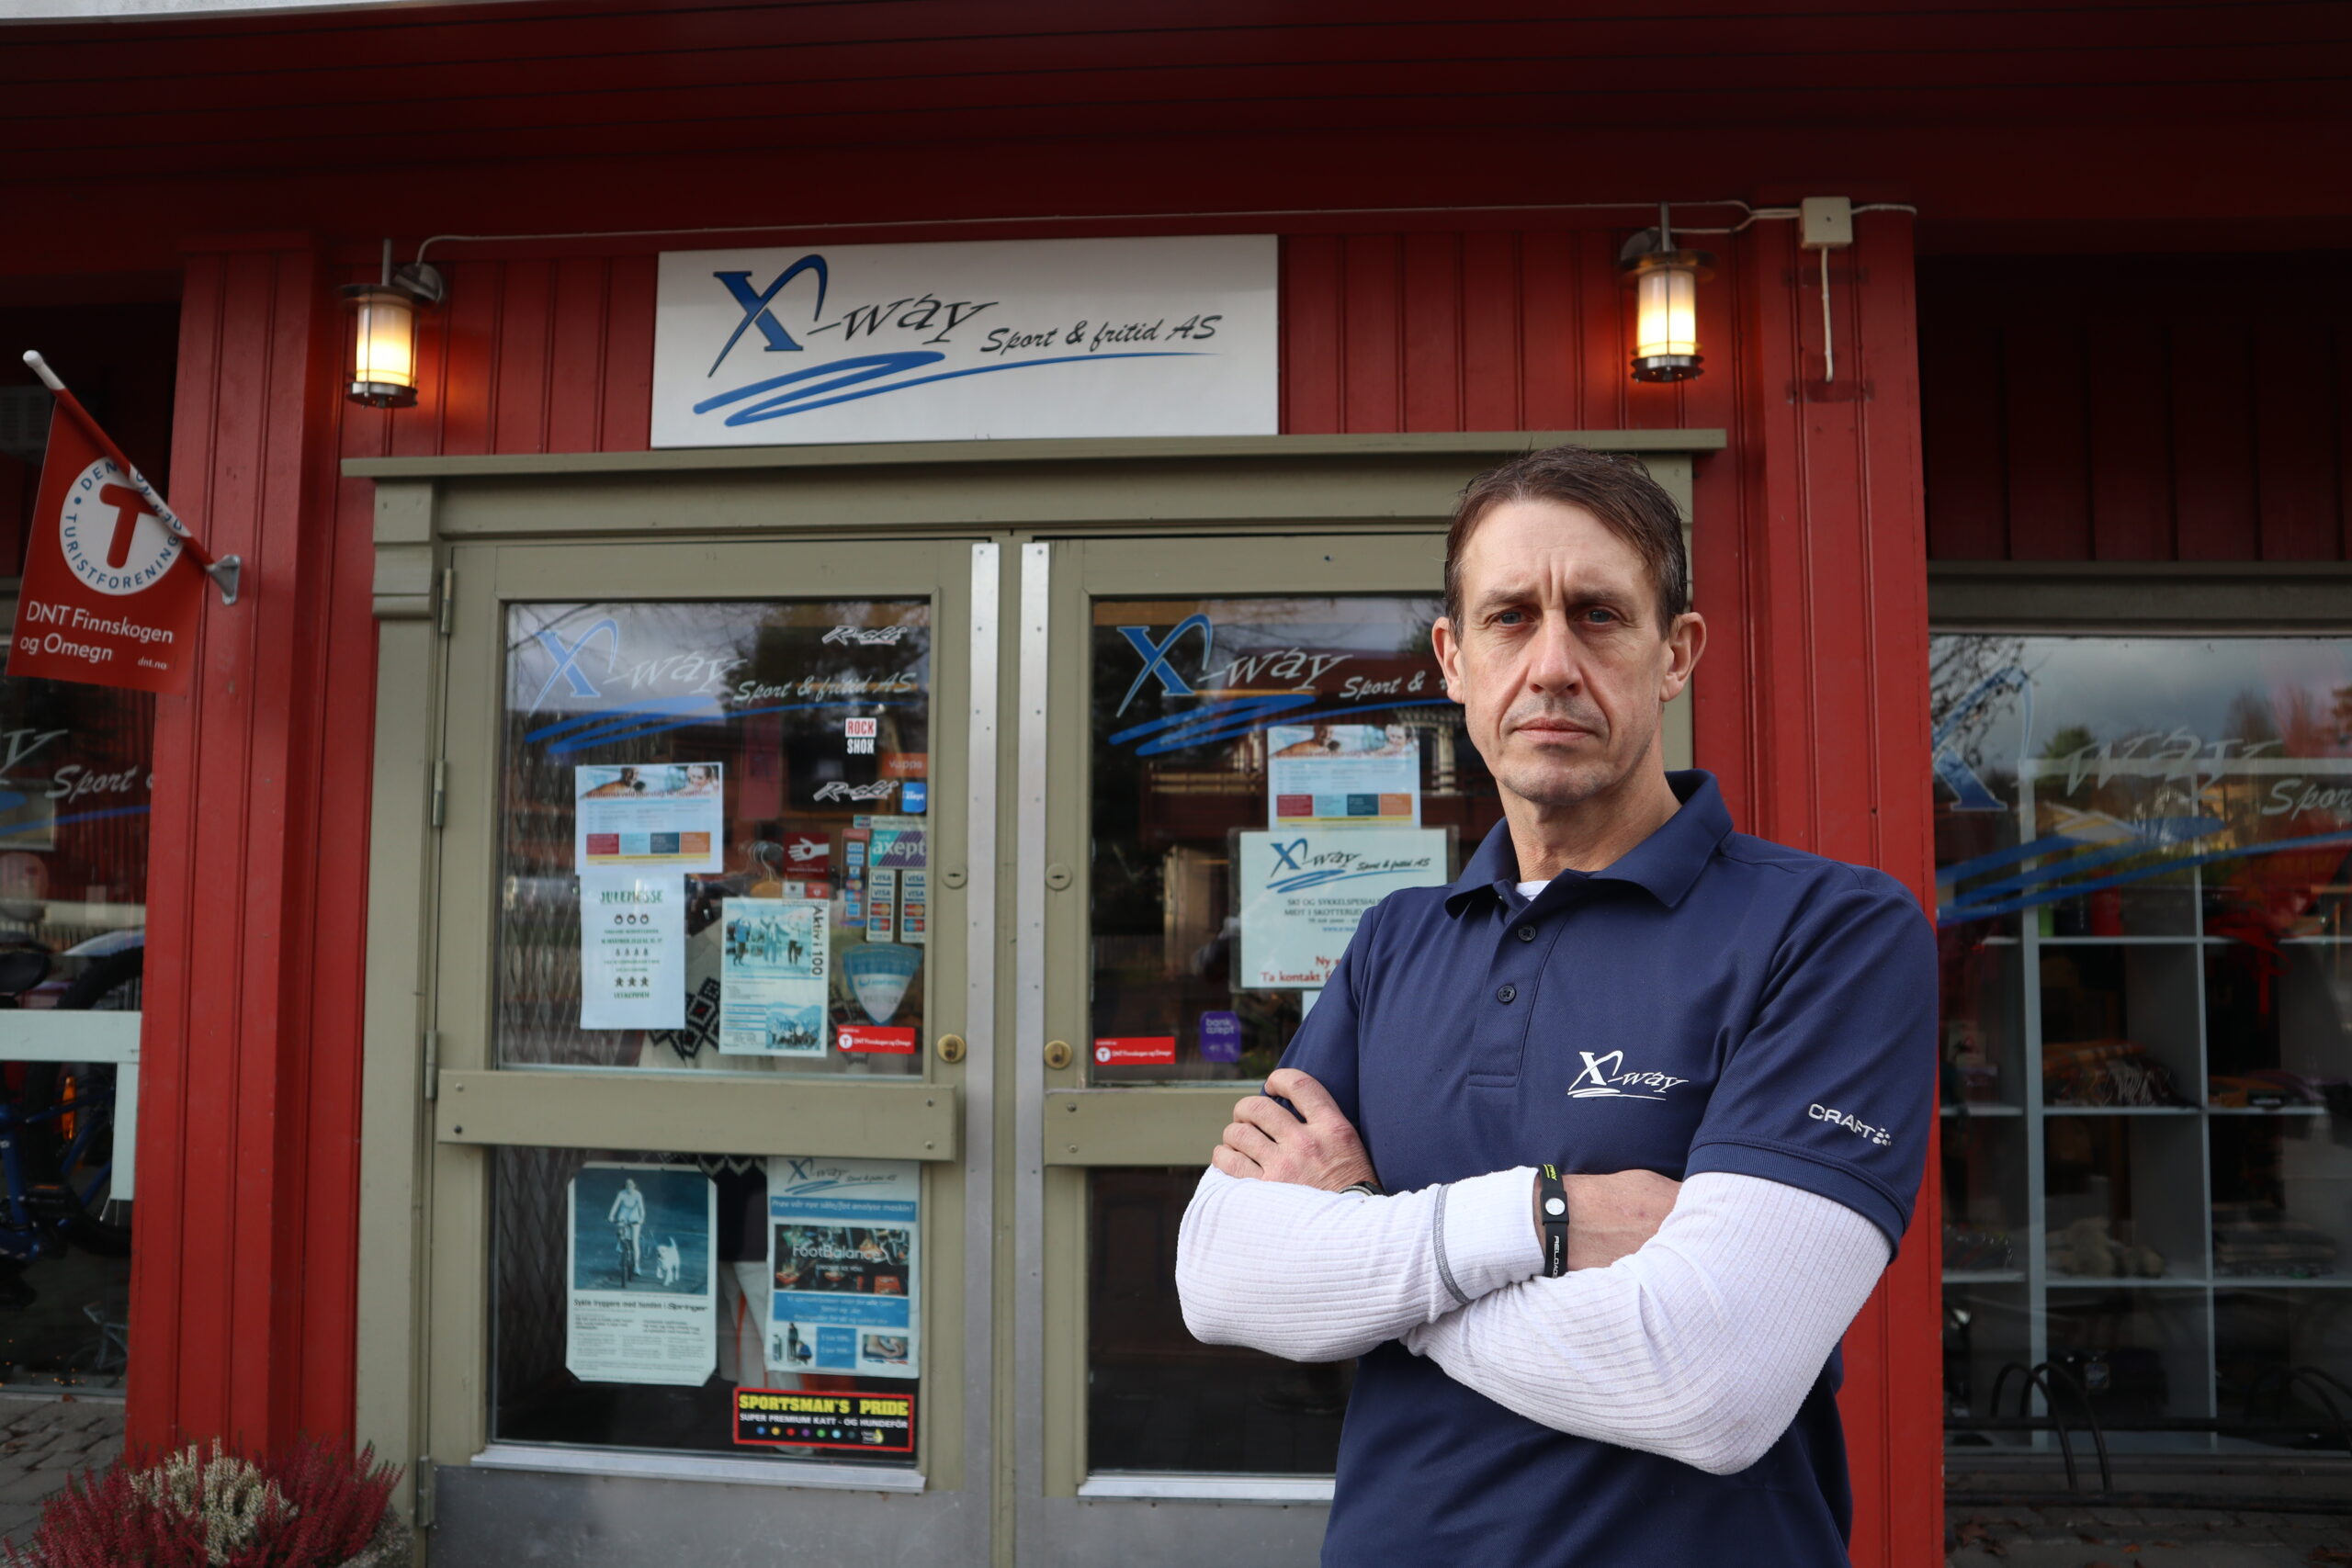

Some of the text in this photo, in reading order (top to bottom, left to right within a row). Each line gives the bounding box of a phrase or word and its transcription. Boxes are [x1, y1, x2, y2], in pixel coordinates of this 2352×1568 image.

[979, 314, 1223, 355] Sport & fritid AS
[80, 461, 118, 491] DEN
[63, 513, 180, 590] TURISTFORENING
[26, 601, 175, 644] DNT Finnskogen
[19, 632, 114, 663] og Omegn
[137, 656, 167, 671] dnt.no
[733, 671, 917, 704] Sport & fritid AS
[1339, 676, 1402, 701] Sport
[1407, 671, 1426, 693] &
[847, 720, 875, 735] ROCK
[846, 739, 875, 754] SHOX
[45, 764, 138, 805] Sport
[2261, 778, 2352, 821] Spor
[873, 838, 926, 862] axept
[813, 905, 824, 939] Aktiv
[812, 951, 824, 976] 100
[1261, 971, 1275, 982] Ta
[1279, 970, 1320, 982] kontakt
[1315, 955, 1330, 969] Ny
[1205, 1018, 1231, 1027] bank
[1808, 1103, 1876, 1140] CRAFT
[738, 1393, 910, 1416] SPORTSMAN'S PRIDE
[739, 1413, 767, 1423] SUPER
[768, 1414, 812, 1425] PREMIUM
[813, 1416, 837, 1426] KATT
[843, 1417, 858, 1427] OG
